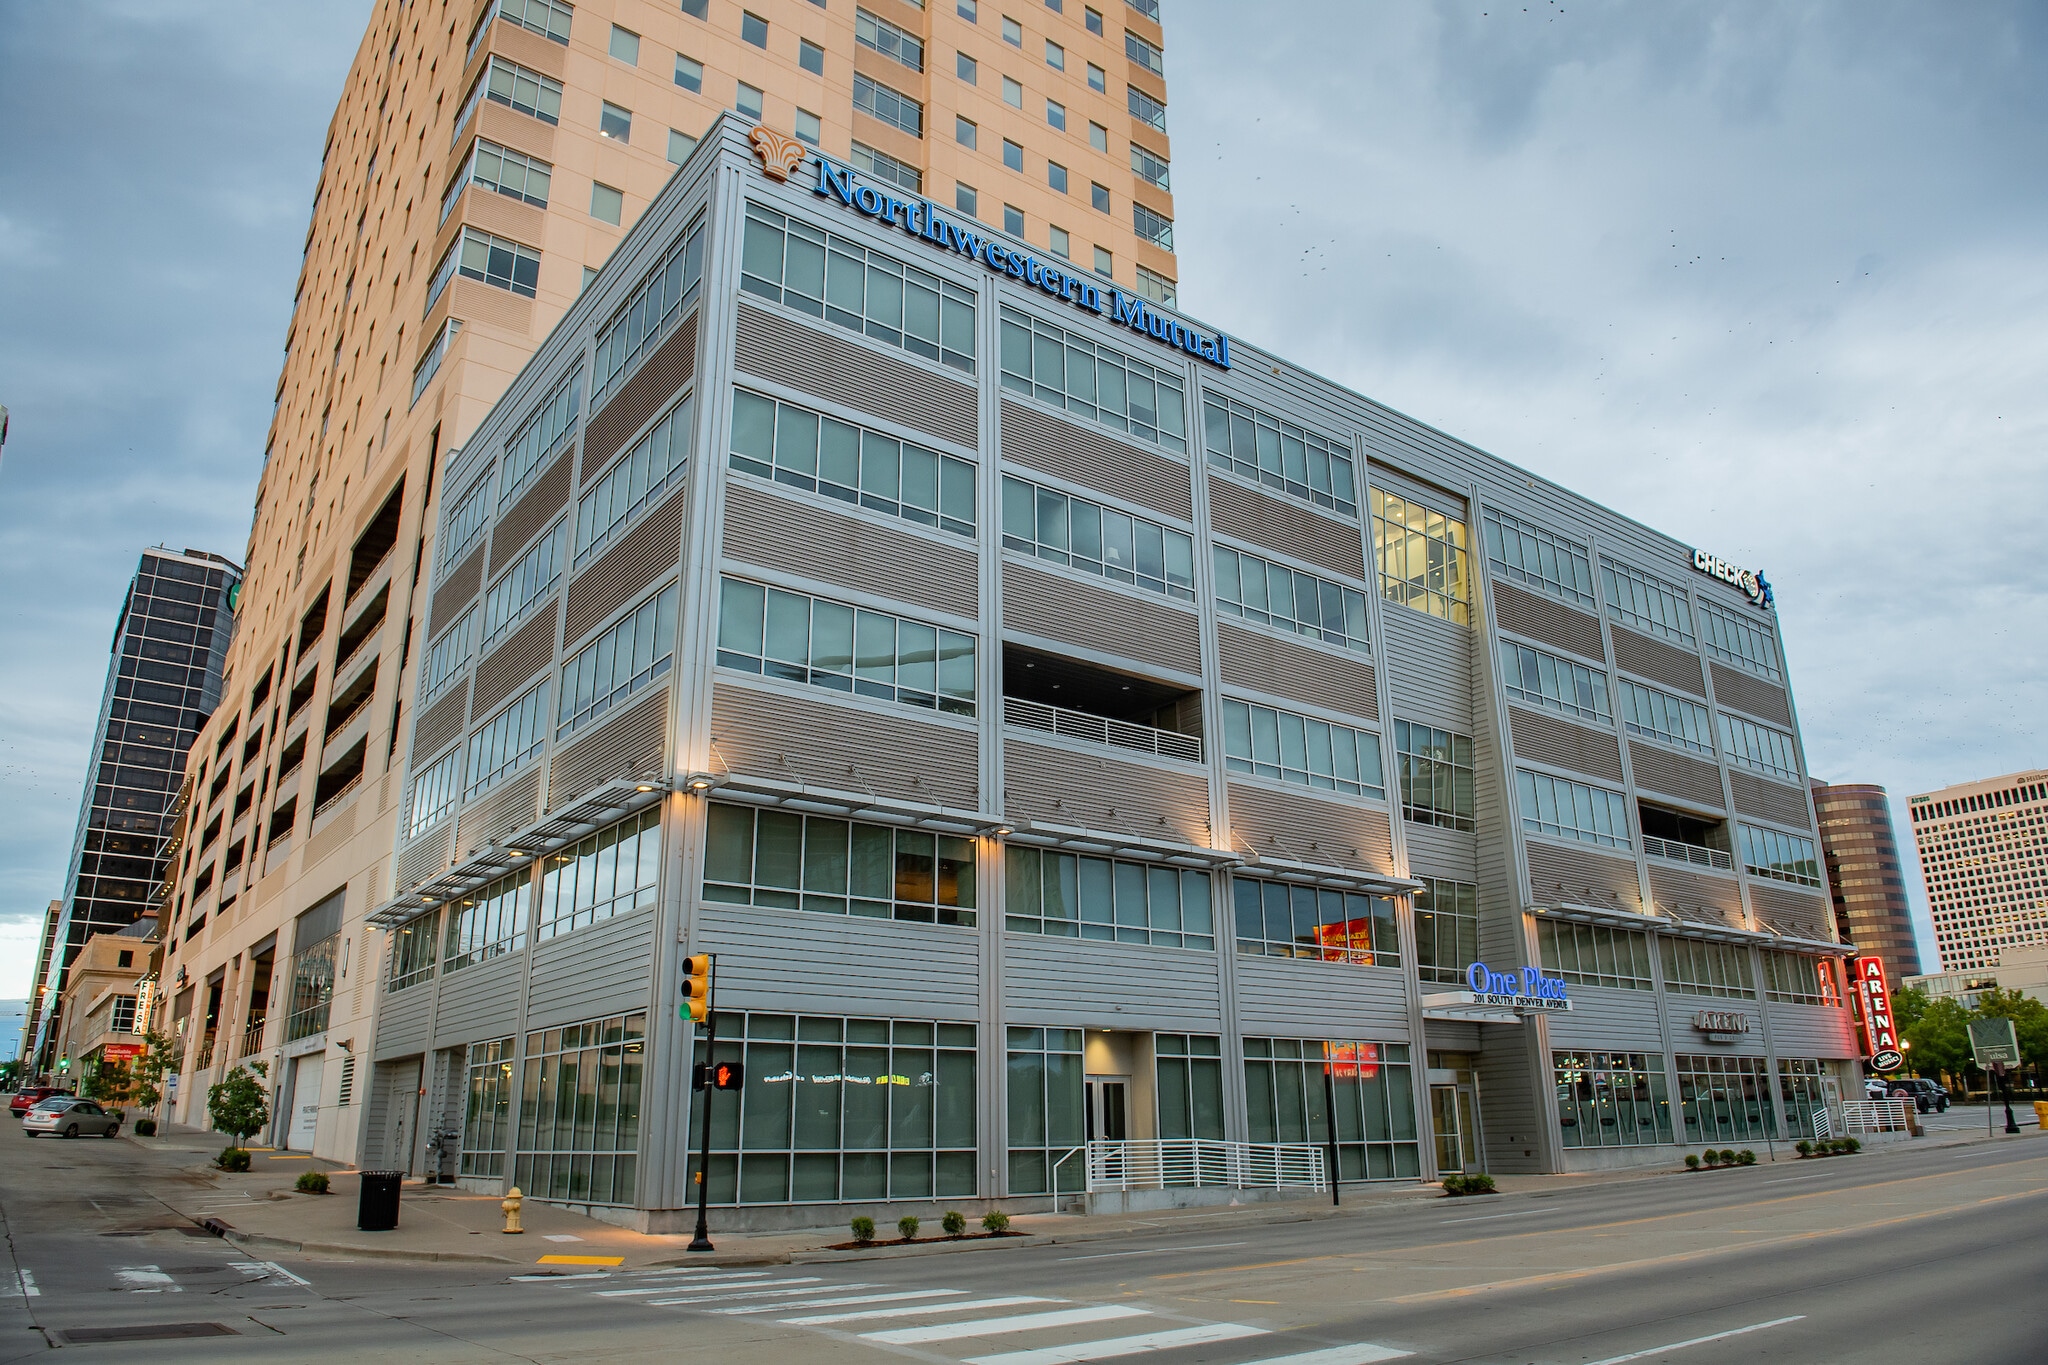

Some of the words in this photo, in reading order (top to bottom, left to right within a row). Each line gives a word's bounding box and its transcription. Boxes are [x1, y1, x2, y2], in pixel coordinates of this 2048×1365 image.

[814, 157, 1102, 316] Northwestern
[1109, 288, 1232, 370] Mutual
[1692, 548, 1744, 589] CHECK
[1467, 961, 1518, 996] One
[1522, 966, 1567, 999] Place
[1473, 994, 1485, 1003] 201
[1487, 994, 1513, 1006] SOUTH
[1516, 997, 1544, 1008] DENVER
[1546, 999, 1568, 1009] AVENUE
[1866, 962, 1894, 1046] ARENA
[1699, 1010, 1750, 1033] ARENA
[1877, 1053, 1892, 1062] LIVE
